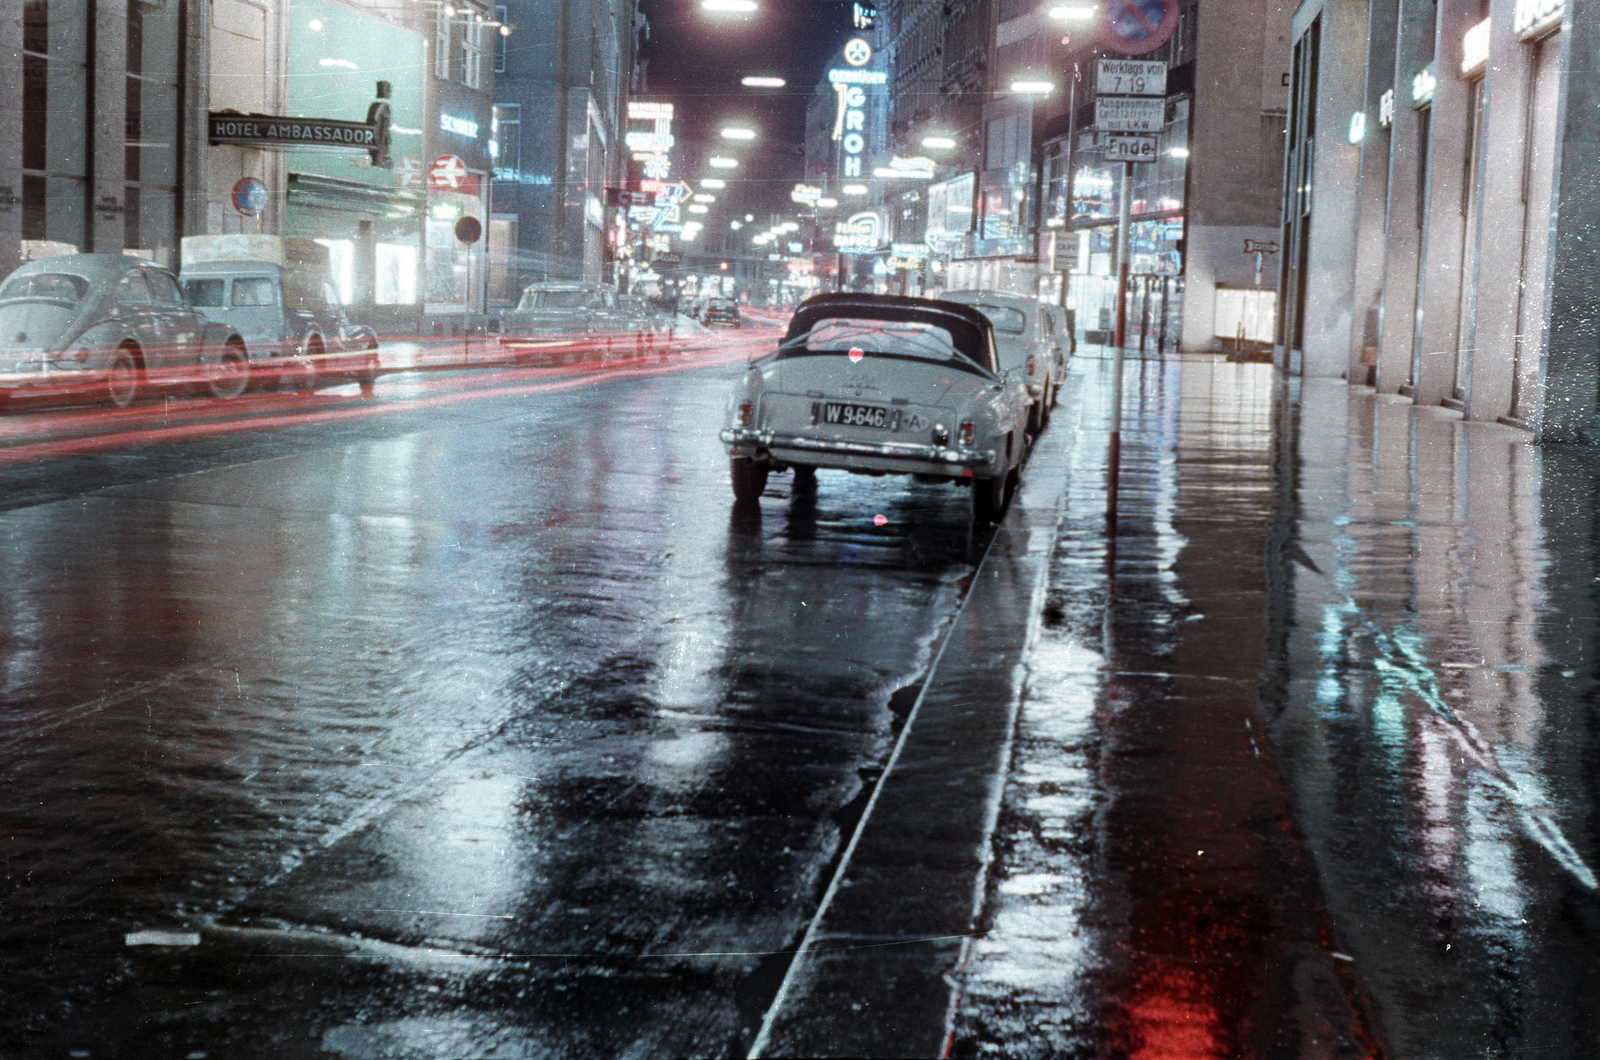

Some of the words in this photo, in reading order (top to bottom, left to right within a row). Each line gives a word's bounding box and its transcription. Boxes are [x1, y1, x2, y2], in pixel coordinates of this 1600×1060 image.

[828, 68, 887, 84] GEBRÜDER
[1103, 61, 1144, 76] Werktags
[1147, 64, 1163, 75] von
[1114, 77, 1122, 92] 7
[1128, 77, 1145, 92] 19
[216, 122, 262, 137] HOTEL
[267, 123, 374, 144] AMBASSADOR
[843, 87, 866, 176] GROH
[1109, 138, 1151, 155] Ende
[826, 404, 842, 423] W
[908, 415, 921, 429] A
